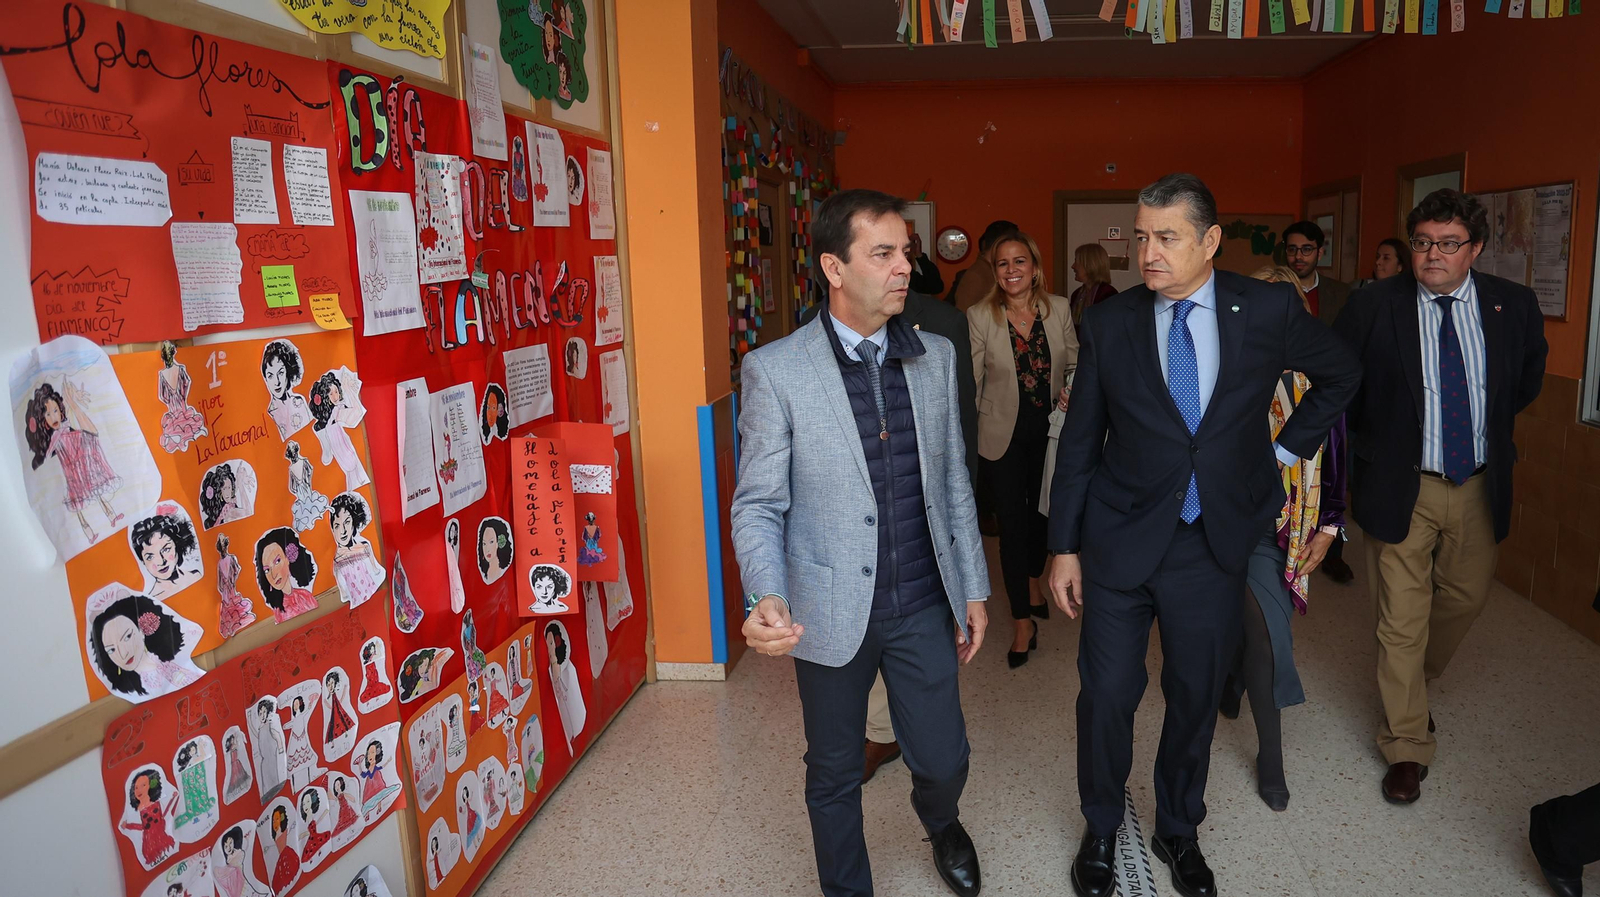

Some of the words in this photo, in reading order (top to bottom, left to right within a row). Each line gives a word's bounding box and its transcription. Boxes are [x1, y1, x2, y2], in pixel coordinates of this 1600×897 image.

[39, 158, 61, 170] María
[60, 203, 69, 211] 35
[67, 279, 119, 294] noviembre
[422, 262, 590, 357] FLAMENCO
[46, 316, 111, 340] FLAMENCO
[1120, 849, 1136, 861] LA
